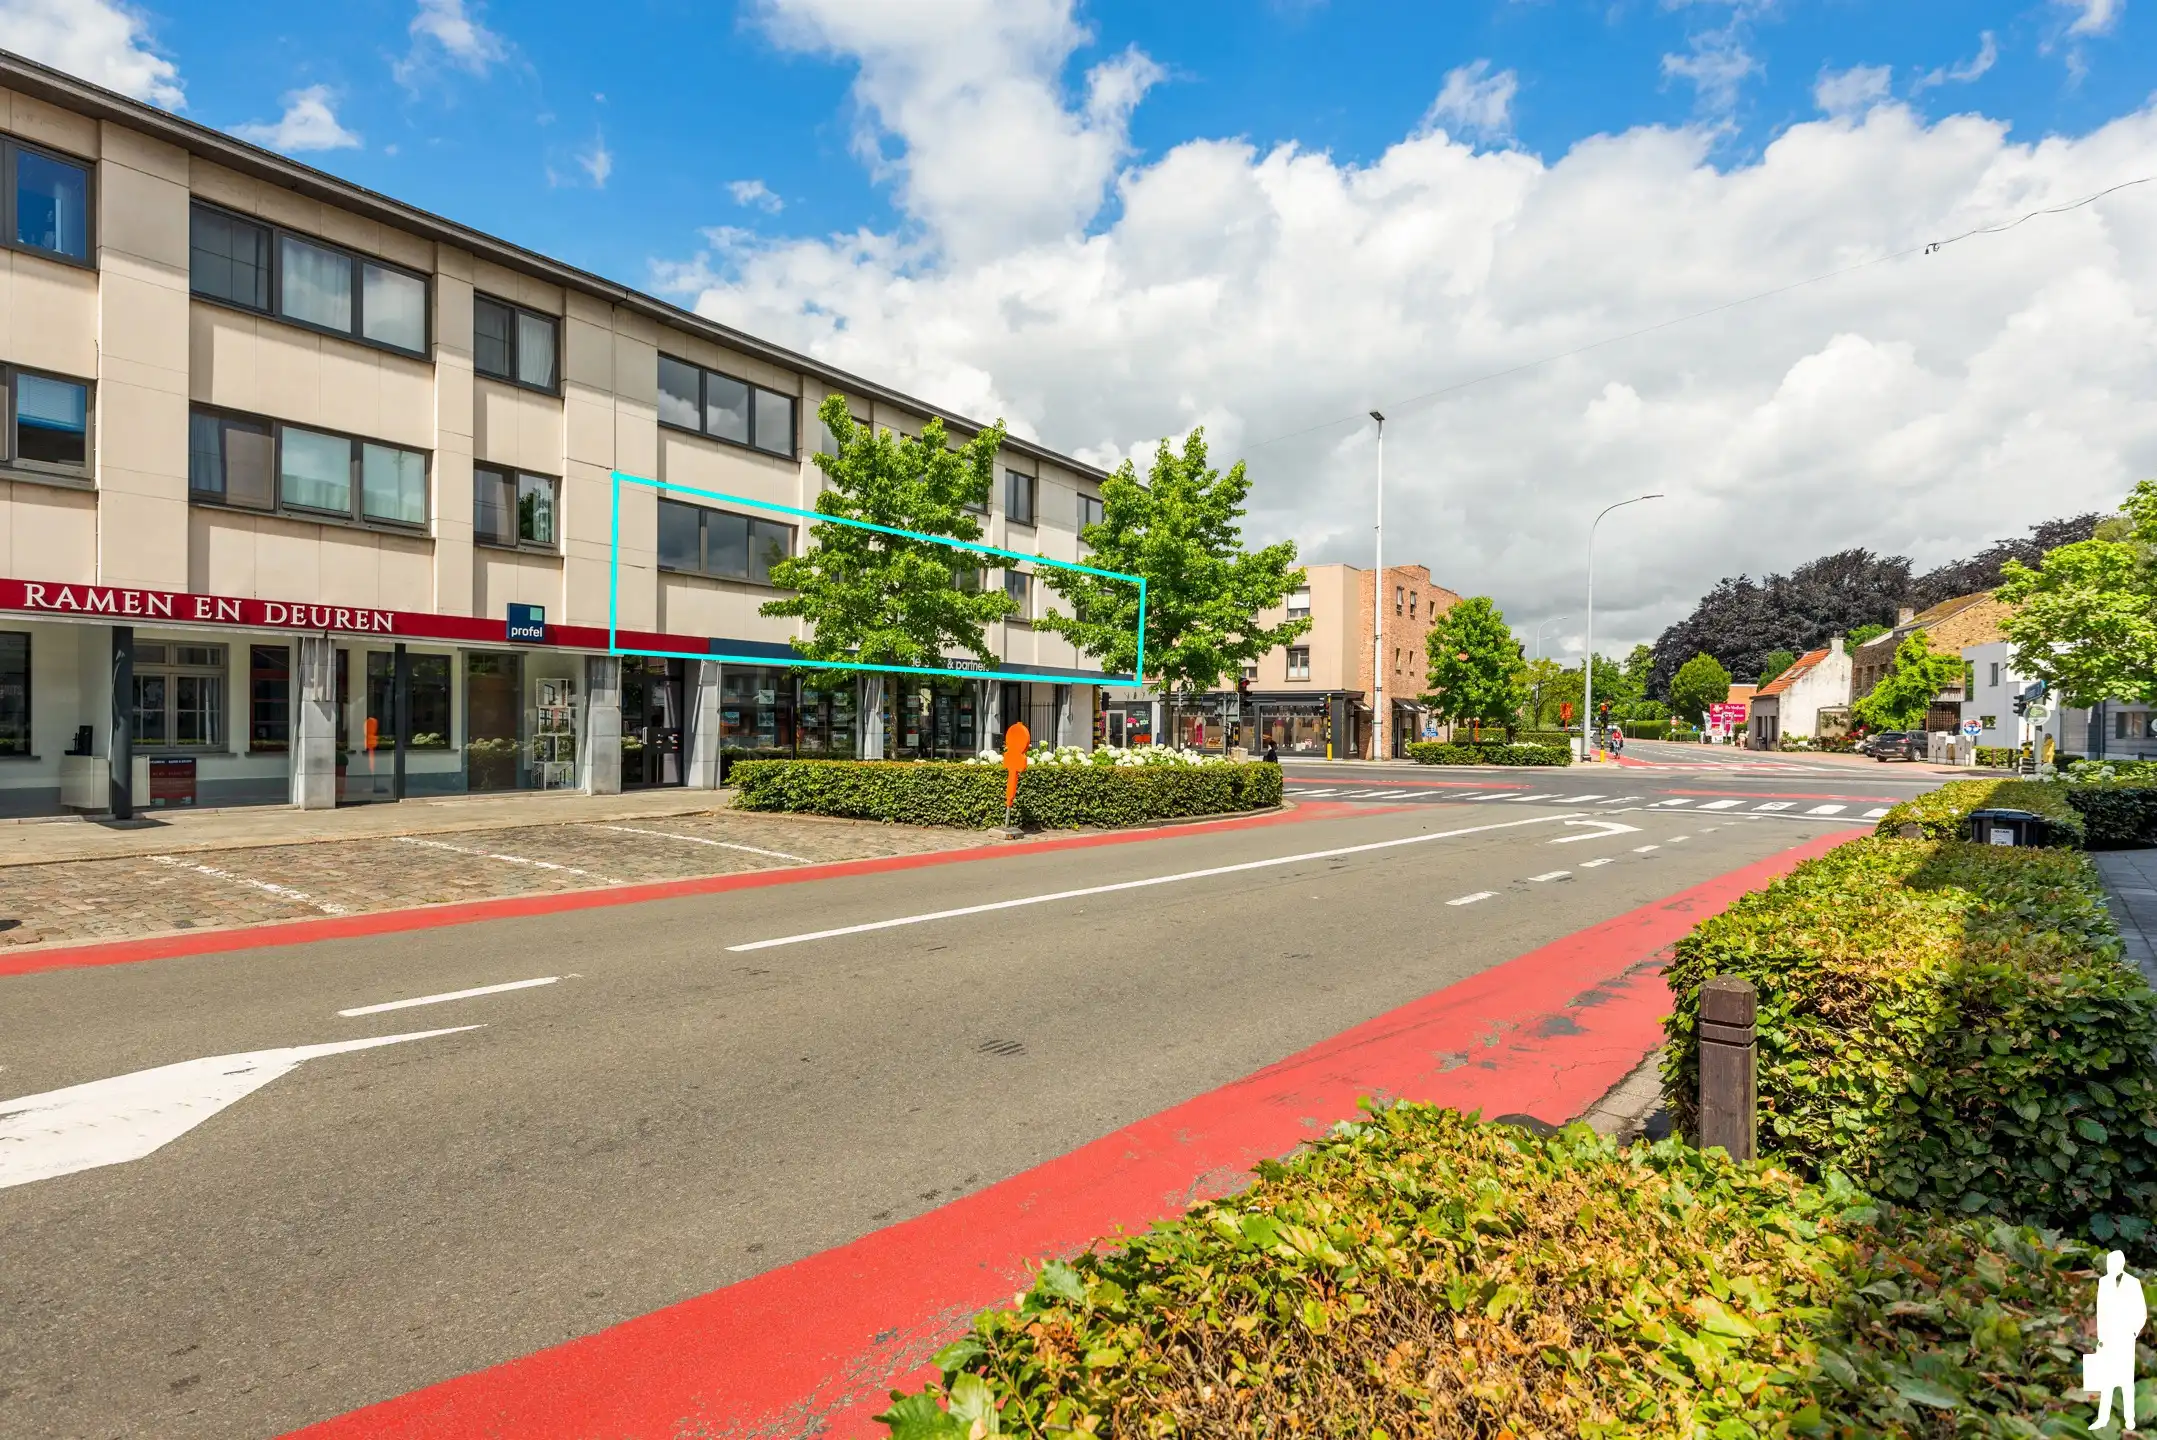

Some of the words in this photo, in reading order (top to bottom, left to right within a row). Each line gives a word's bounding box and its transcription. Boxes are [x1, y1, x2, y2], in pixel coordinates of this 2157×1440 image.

[23, 583, 173, 617] RAMEN
[194, 597, 242, 621] EN
[264, 602, 394, 632] DEUREN
[511, 626, 542, 638] profel
